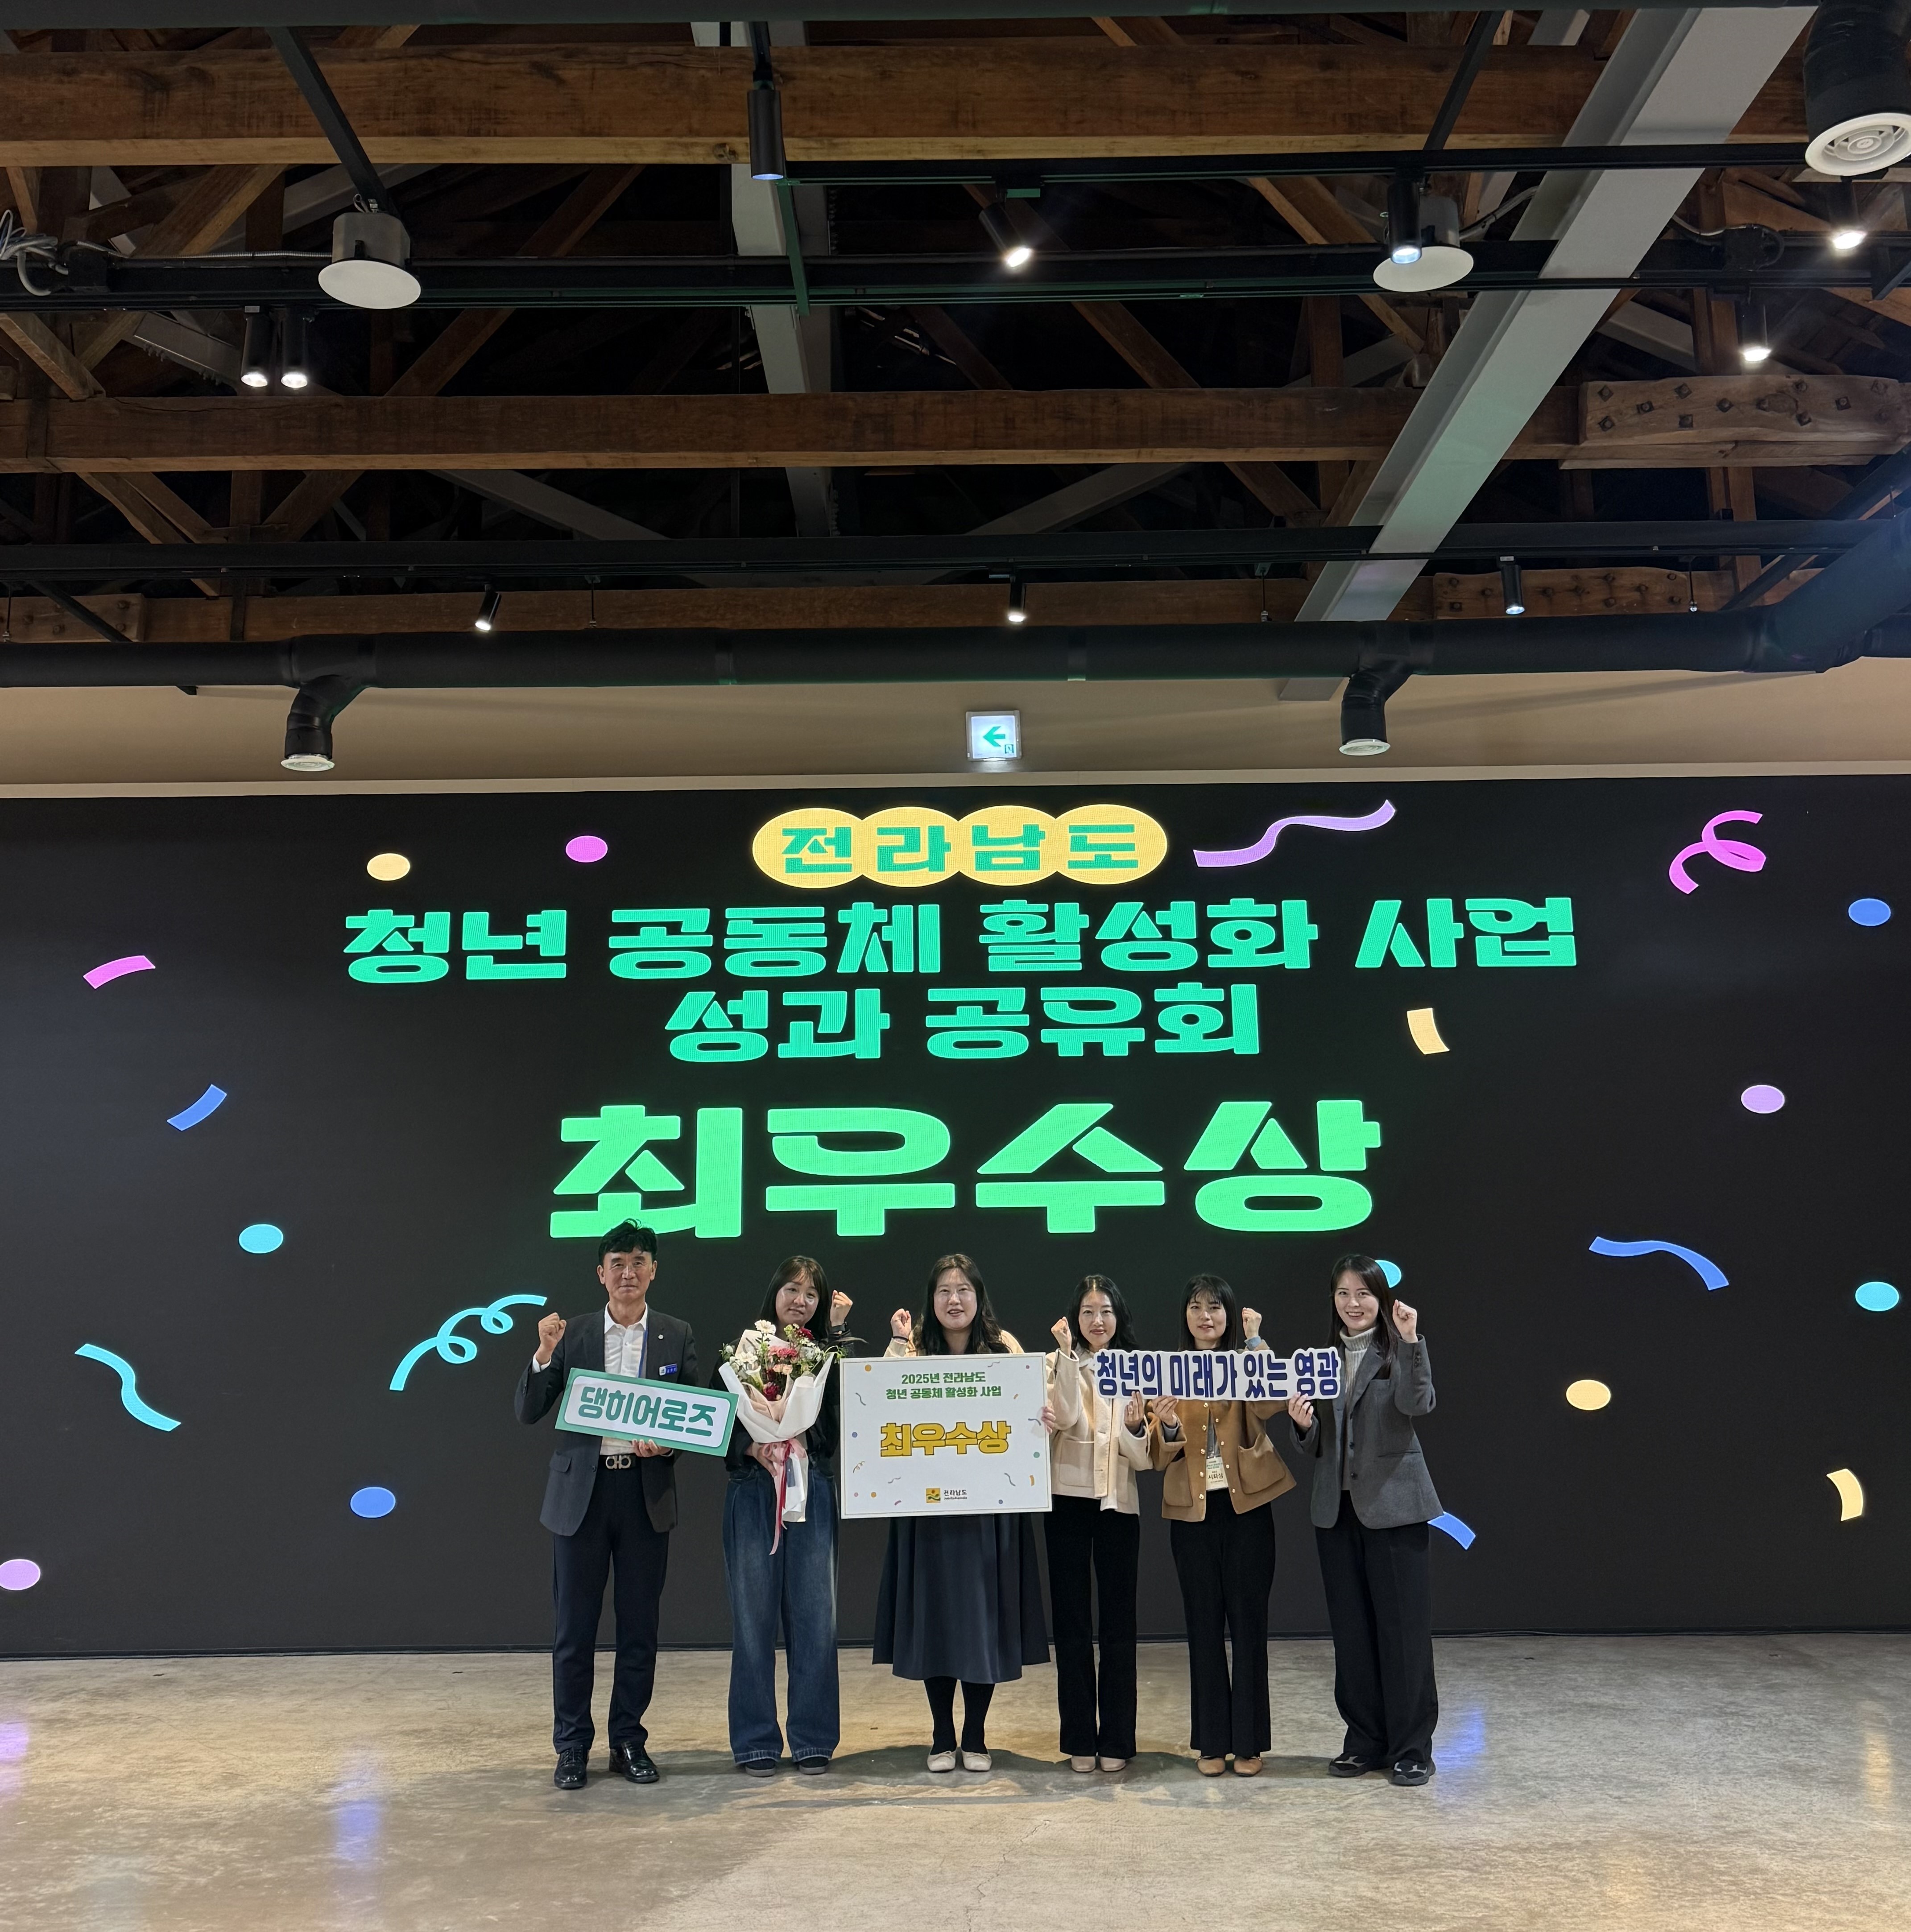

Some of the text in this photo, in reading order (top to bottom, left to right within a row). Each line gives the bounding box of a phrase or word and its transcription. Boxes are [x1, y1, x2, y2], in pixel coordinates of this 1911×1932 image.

[781, 824, 1138, 874] 전라남도
[343, 897, 1576, 983] 청년 공동체 활성화 사업
[665, 982, 1260, 1062] 성과 공유회
[550, 1099, 1382, 1238] 최우수상
[886, 1385, 1001, 1399] 청년 공동체 활성화 사업
[902, 1371, 986, 1384] 2025년 전라남도
[1096, 1350, 1339, 1399] 청년의 미래가 있는 영광
[578, 1386, 716, 1437] 댕히어로즈
[880, 1420, 1012, 1457] 최우수상
